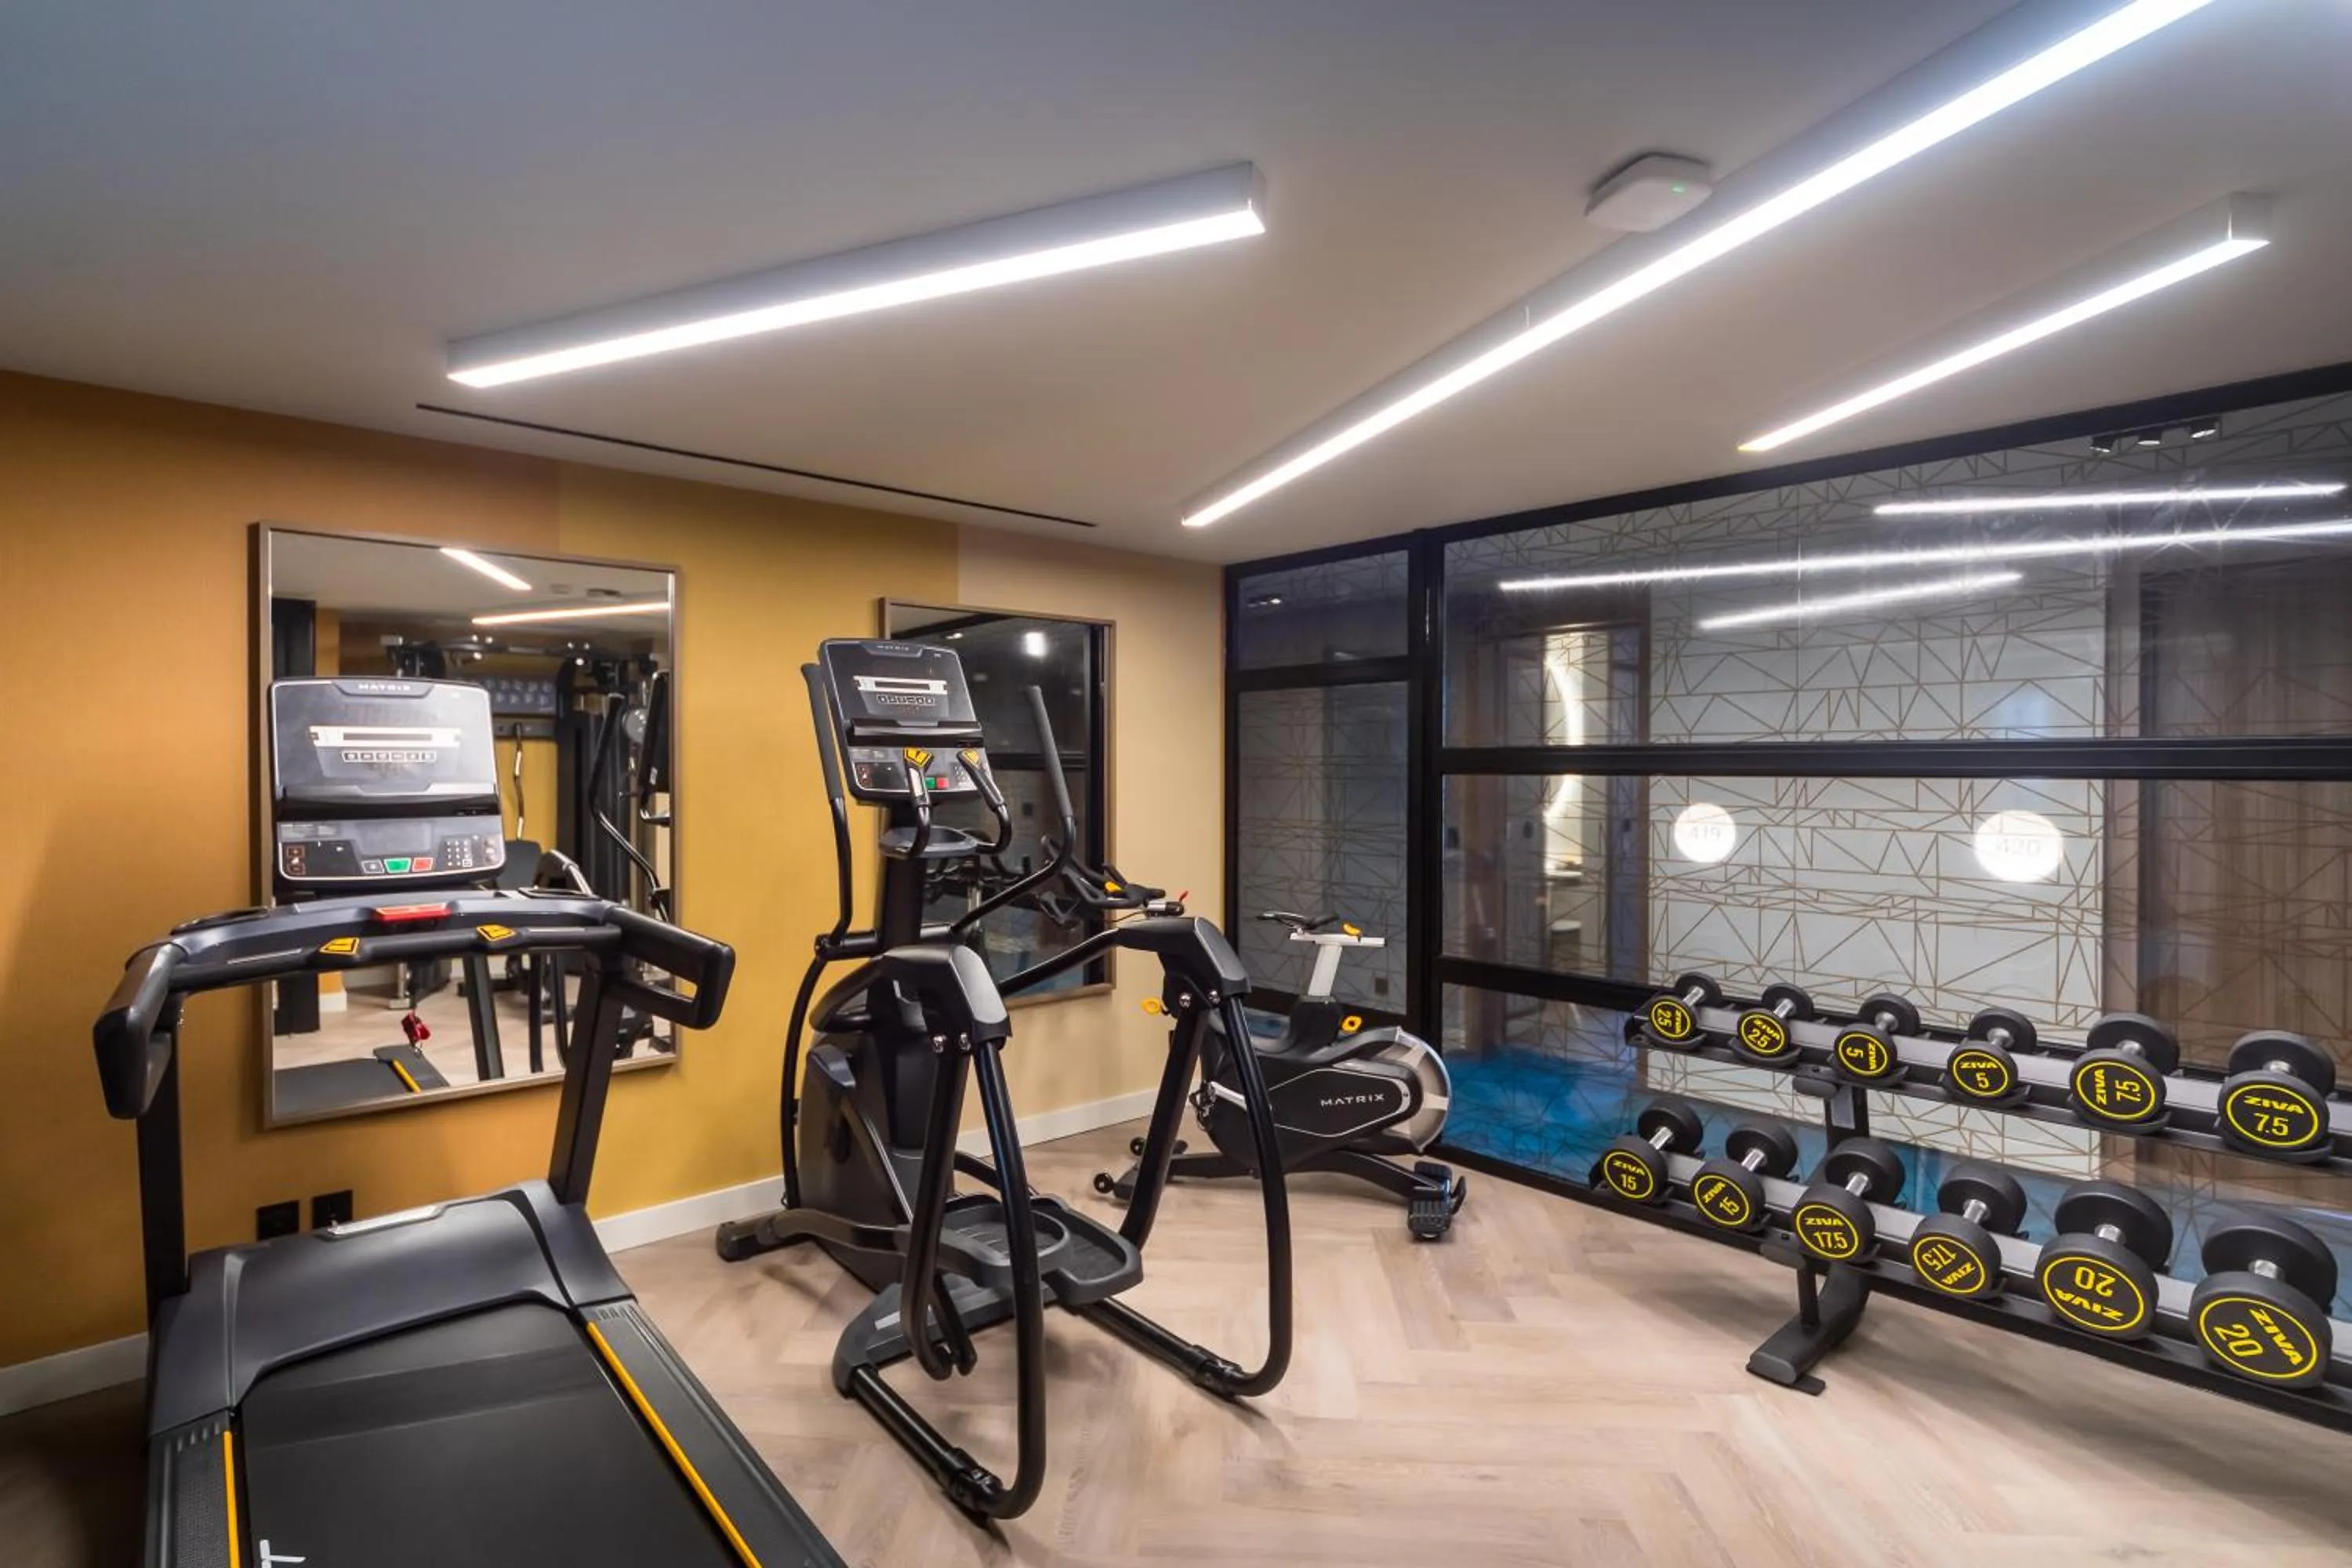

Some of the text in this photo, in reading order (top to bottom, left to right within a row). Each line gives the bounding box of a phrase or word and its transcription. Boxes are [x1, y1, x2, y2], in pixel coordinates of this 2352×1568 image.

[1846, 1047, 1864, 1058] 5
[1868, 1042, 1877, 1070] ZIVA
[1961, 1061, 1998, 1069] ZIVA
[1975, 1072, 1989, 1088] 5
[2095, 1068, 2107, 1105] ZIVA
[2116, 1079, 2142, 1102] 7.5
[1320, 1094, 1385, 1107] MATRIX
[2243, 1094, 2304, 1115] ZIVA
[2252, 1112, 2289, 1137] 7.5
[1613, 1160, 1646, 1176] ZIVA
[1621, 1174, 1637, 1191] 15
[1701, 1181, 1726, 1203] ZIVA
[1718, 1196, 1740, 1216] 15
[1805, 1218, 1845, 1226] ZIVA
[1941, 1261, 1976, 1286] ZIVA
[2074, 1265, 2117, 1298] 20
[2054, 1288, 2125, 1322] ZIVA
[2213, 1323, 2263, 1357] 20
[2248, 1308, 2303, 1366] ZIVA
